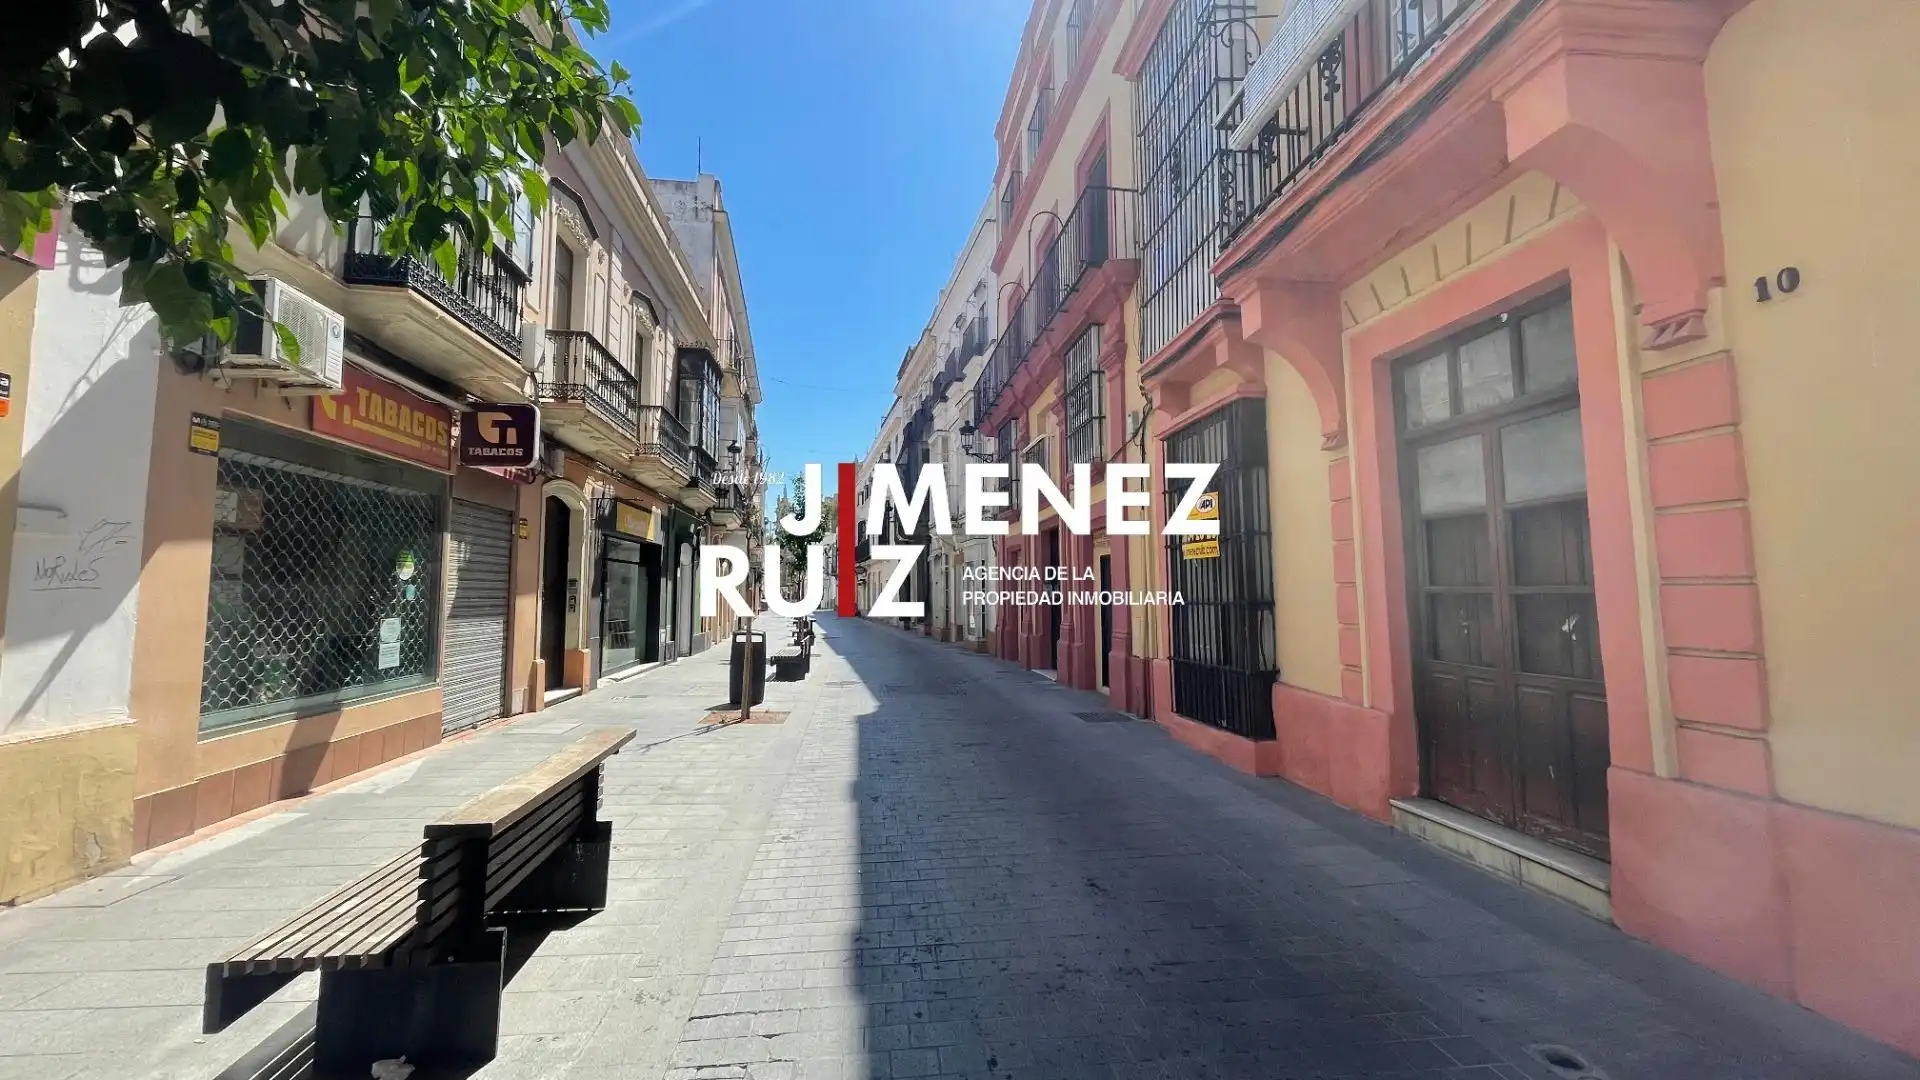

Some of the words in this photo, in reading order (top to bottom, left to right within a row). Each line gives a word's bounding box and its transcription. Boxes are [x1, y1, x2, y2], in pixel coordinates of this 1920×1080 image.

[1754, 266, 1801, 303] 10
[356, 386, 449, 447] TABACOS
[467, 447, 525, 457] TABACOS
